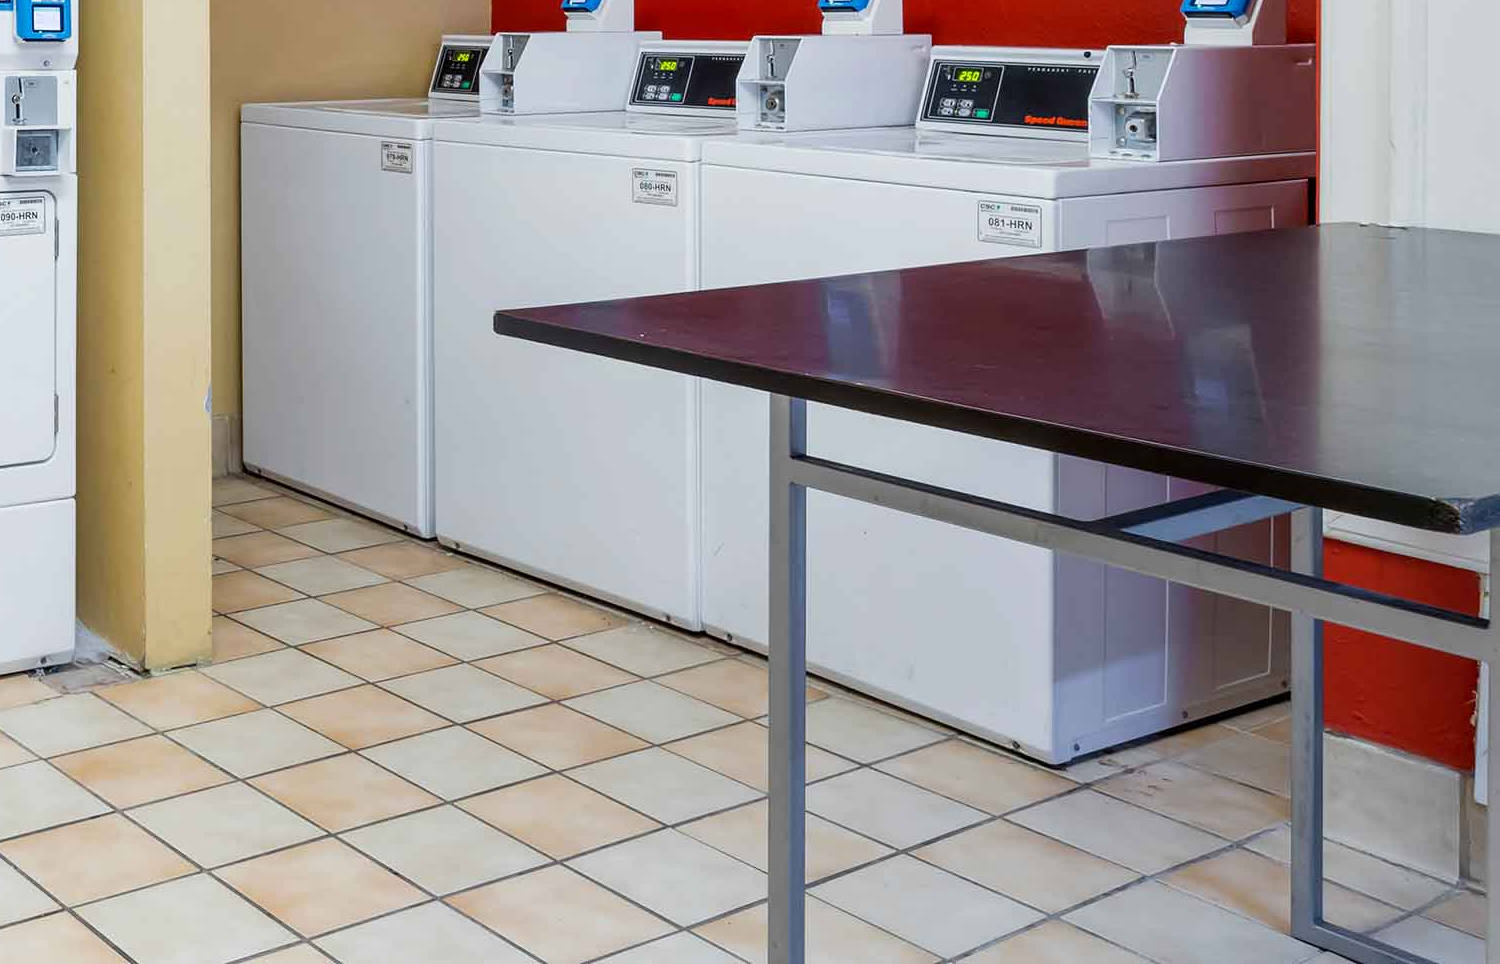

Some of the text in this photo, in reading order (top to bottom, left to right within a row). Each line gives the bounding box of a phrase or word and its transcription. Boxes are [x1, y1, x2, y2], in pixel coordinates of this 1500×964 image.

[660, 61, 678, 71] 250
[959, 71, 980, 82] 250
[1024, 116, 1088, 127] Speed Queen
[0, 212, 38, 221] 090-HRN
[988, 217, 1032, 230] 081-HRN
